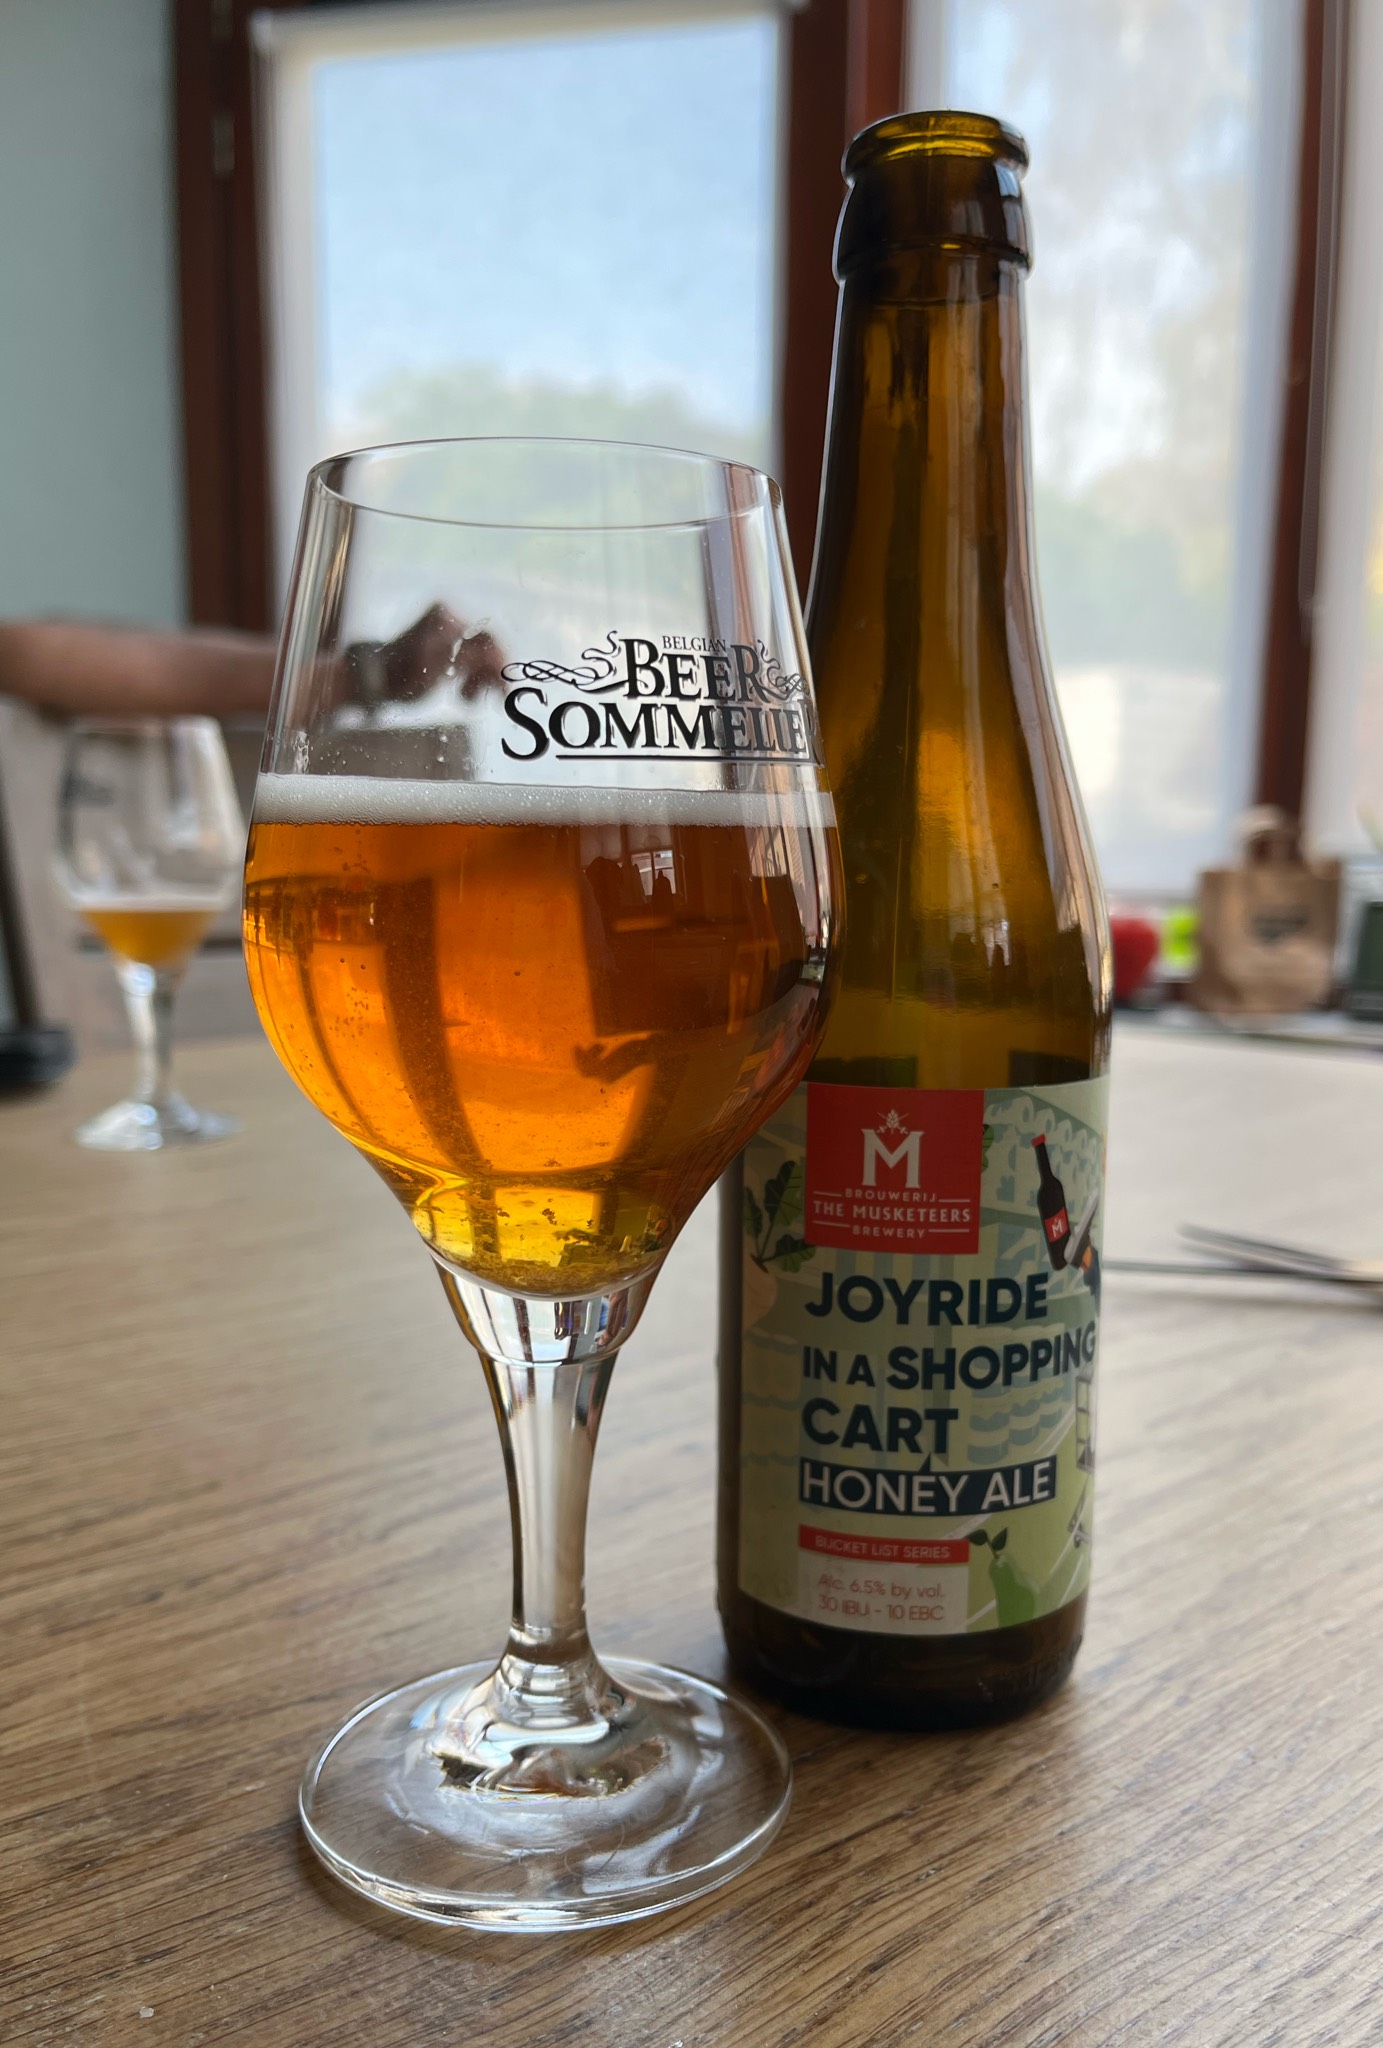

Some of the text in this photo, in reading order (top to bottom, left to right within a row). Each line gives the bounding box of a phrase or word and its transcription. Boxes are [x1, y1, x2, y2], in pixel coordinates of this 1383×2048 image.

[662, 635, 727, 653] BELGIAN
[619, 638, 771, 703] BEER
[861, 1128, 924, 1189] M
[845, 1188, 937, 1203] BROUWERIJ
[813, 1200, 971, 1222] THE MUSKETEERS
[852, 1226, 925, 1238] BREWERY
[805, 1271, 1049, 1326] JOYRIDE
[802, 1321, 1096, 1390] IN A SHOPPING
[802, 1397, 959, 1454] CART
[803, 1460, 1050, 1512] HONEY ALE
[815, 1535, 951, 1559] BUCKET LIST SERIES
[850, 1579, 887, 1595] 6.5%
[891, 1582, 912, 1600] by
[917, 1583, 945, 1598] vol.
[818, 1593, 838, 1612] 30
[842, 1599, 870, 1616] IBU
[887, 1604, 905, 1620] 10
[909, 1604, 945, 1621] EBC
